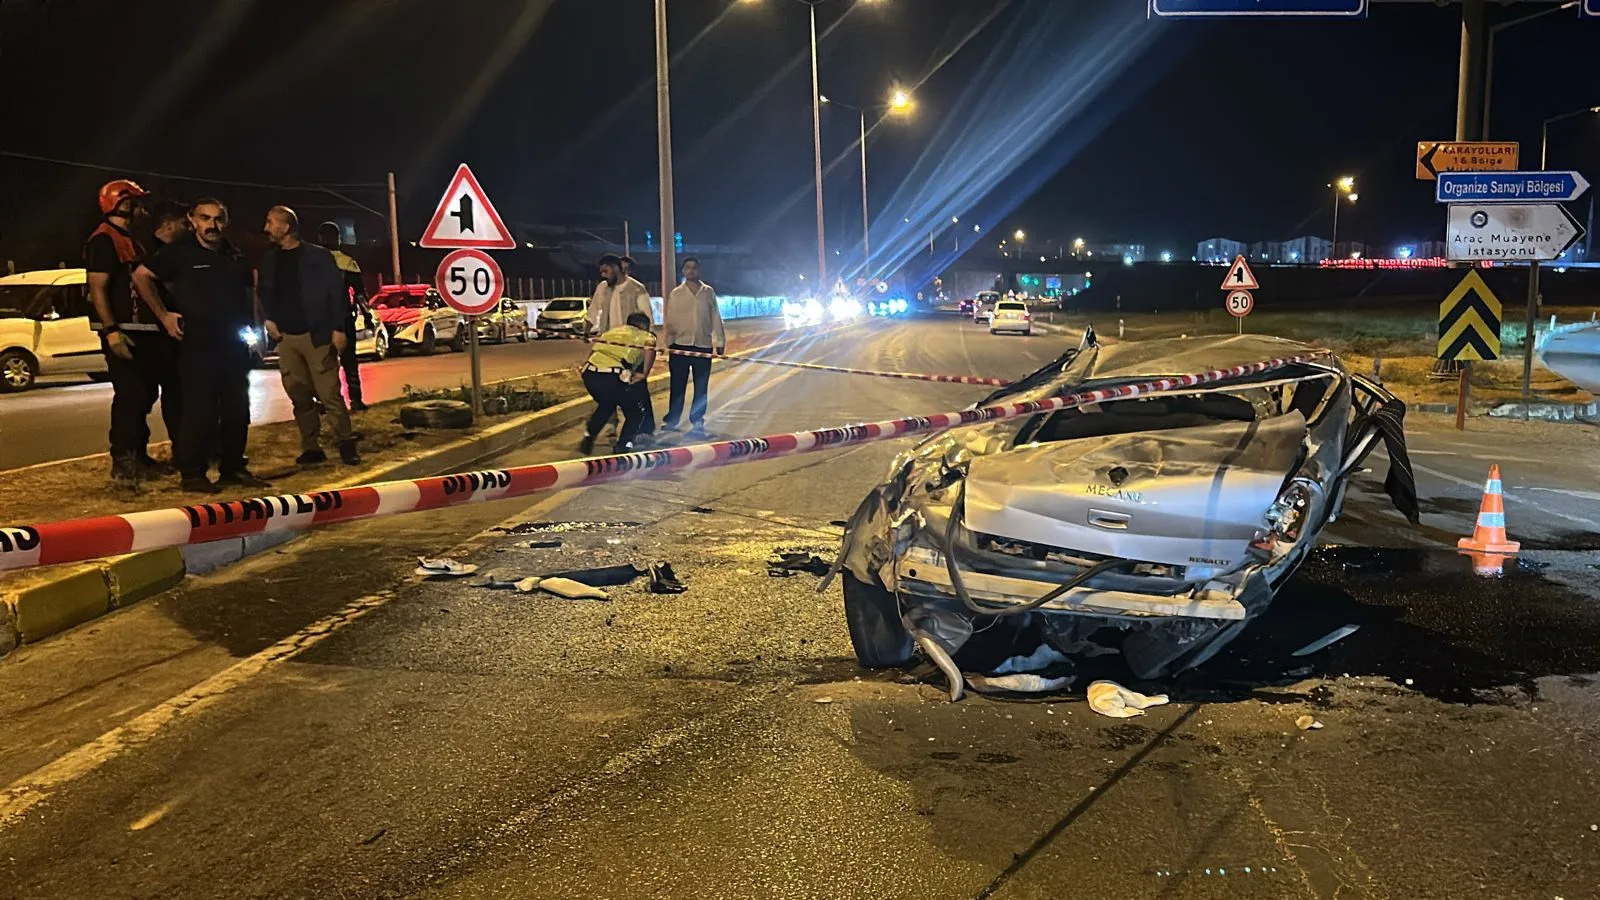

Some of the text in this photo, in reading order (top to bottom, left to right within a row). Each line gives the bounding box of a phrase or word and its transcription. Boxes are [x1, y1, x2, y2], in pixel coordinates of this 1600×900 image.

[1443, 146, 1515, 155] KARAYOLLARI
[1444, 179, 1565, 197] Organize Sanayi Bölgesi
[1454, 233, 1552, 245] Araç Muayene
[450, 266, 490, 296] 50
[1232, 296, 1249, 309] 50
[1188, 556, 1232, 566] RENAULT
